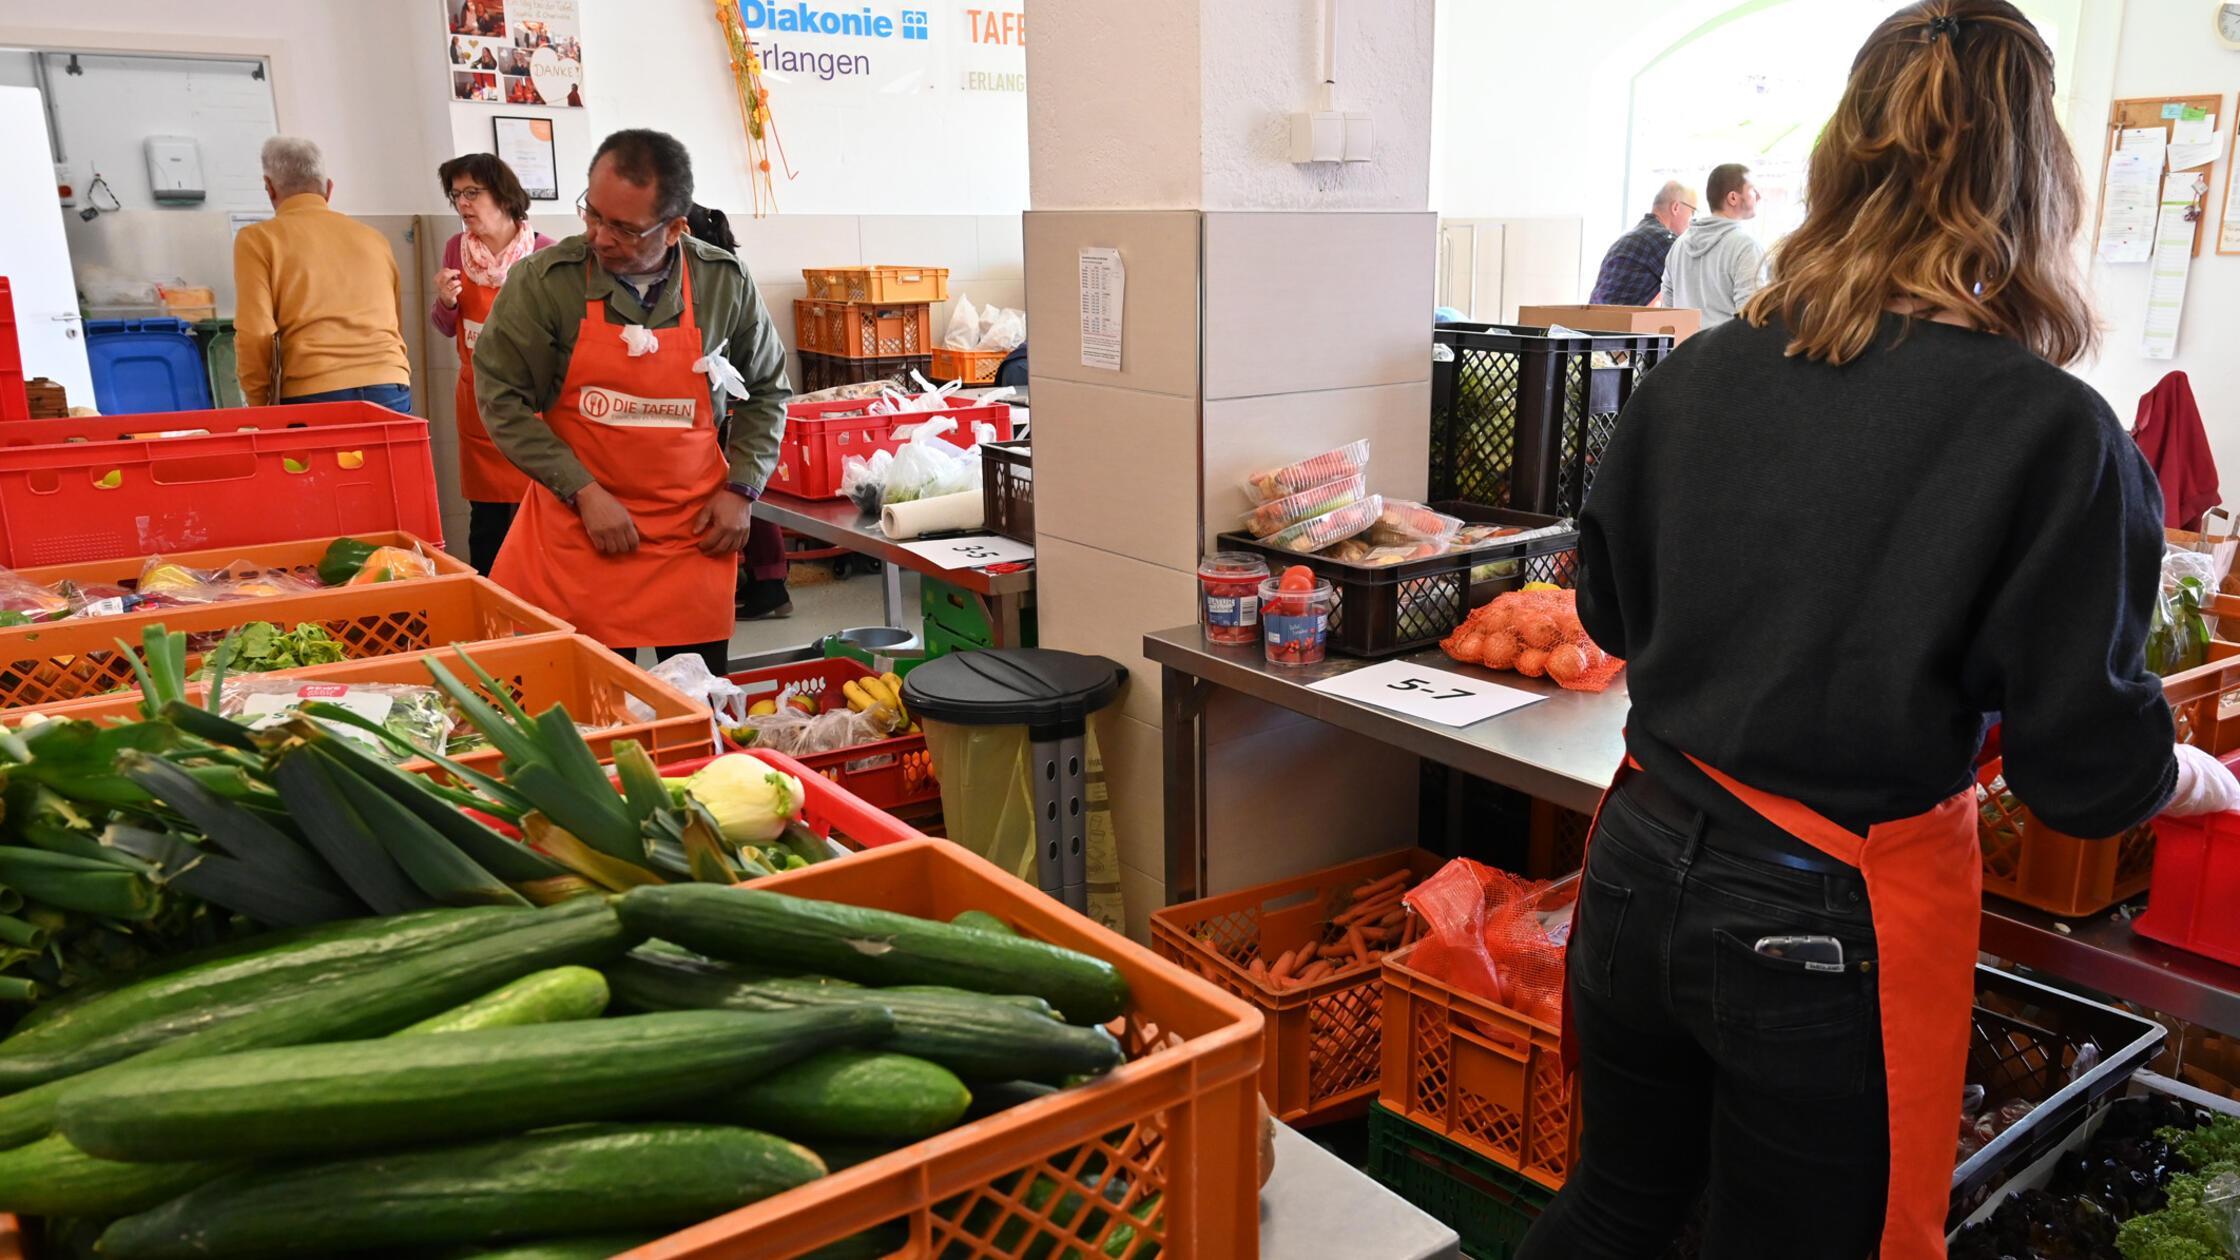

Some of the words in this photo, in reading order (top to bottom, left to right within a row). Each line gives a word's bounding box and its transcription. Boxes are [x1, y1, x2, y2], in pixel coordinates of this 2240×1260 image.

[740, 0, 893, 38] Diakonie
[613, 398, 637, 414] DIE
[642, 403, 692, 417] TAFELN
[1386, 678, 1476, 700] 5-7
